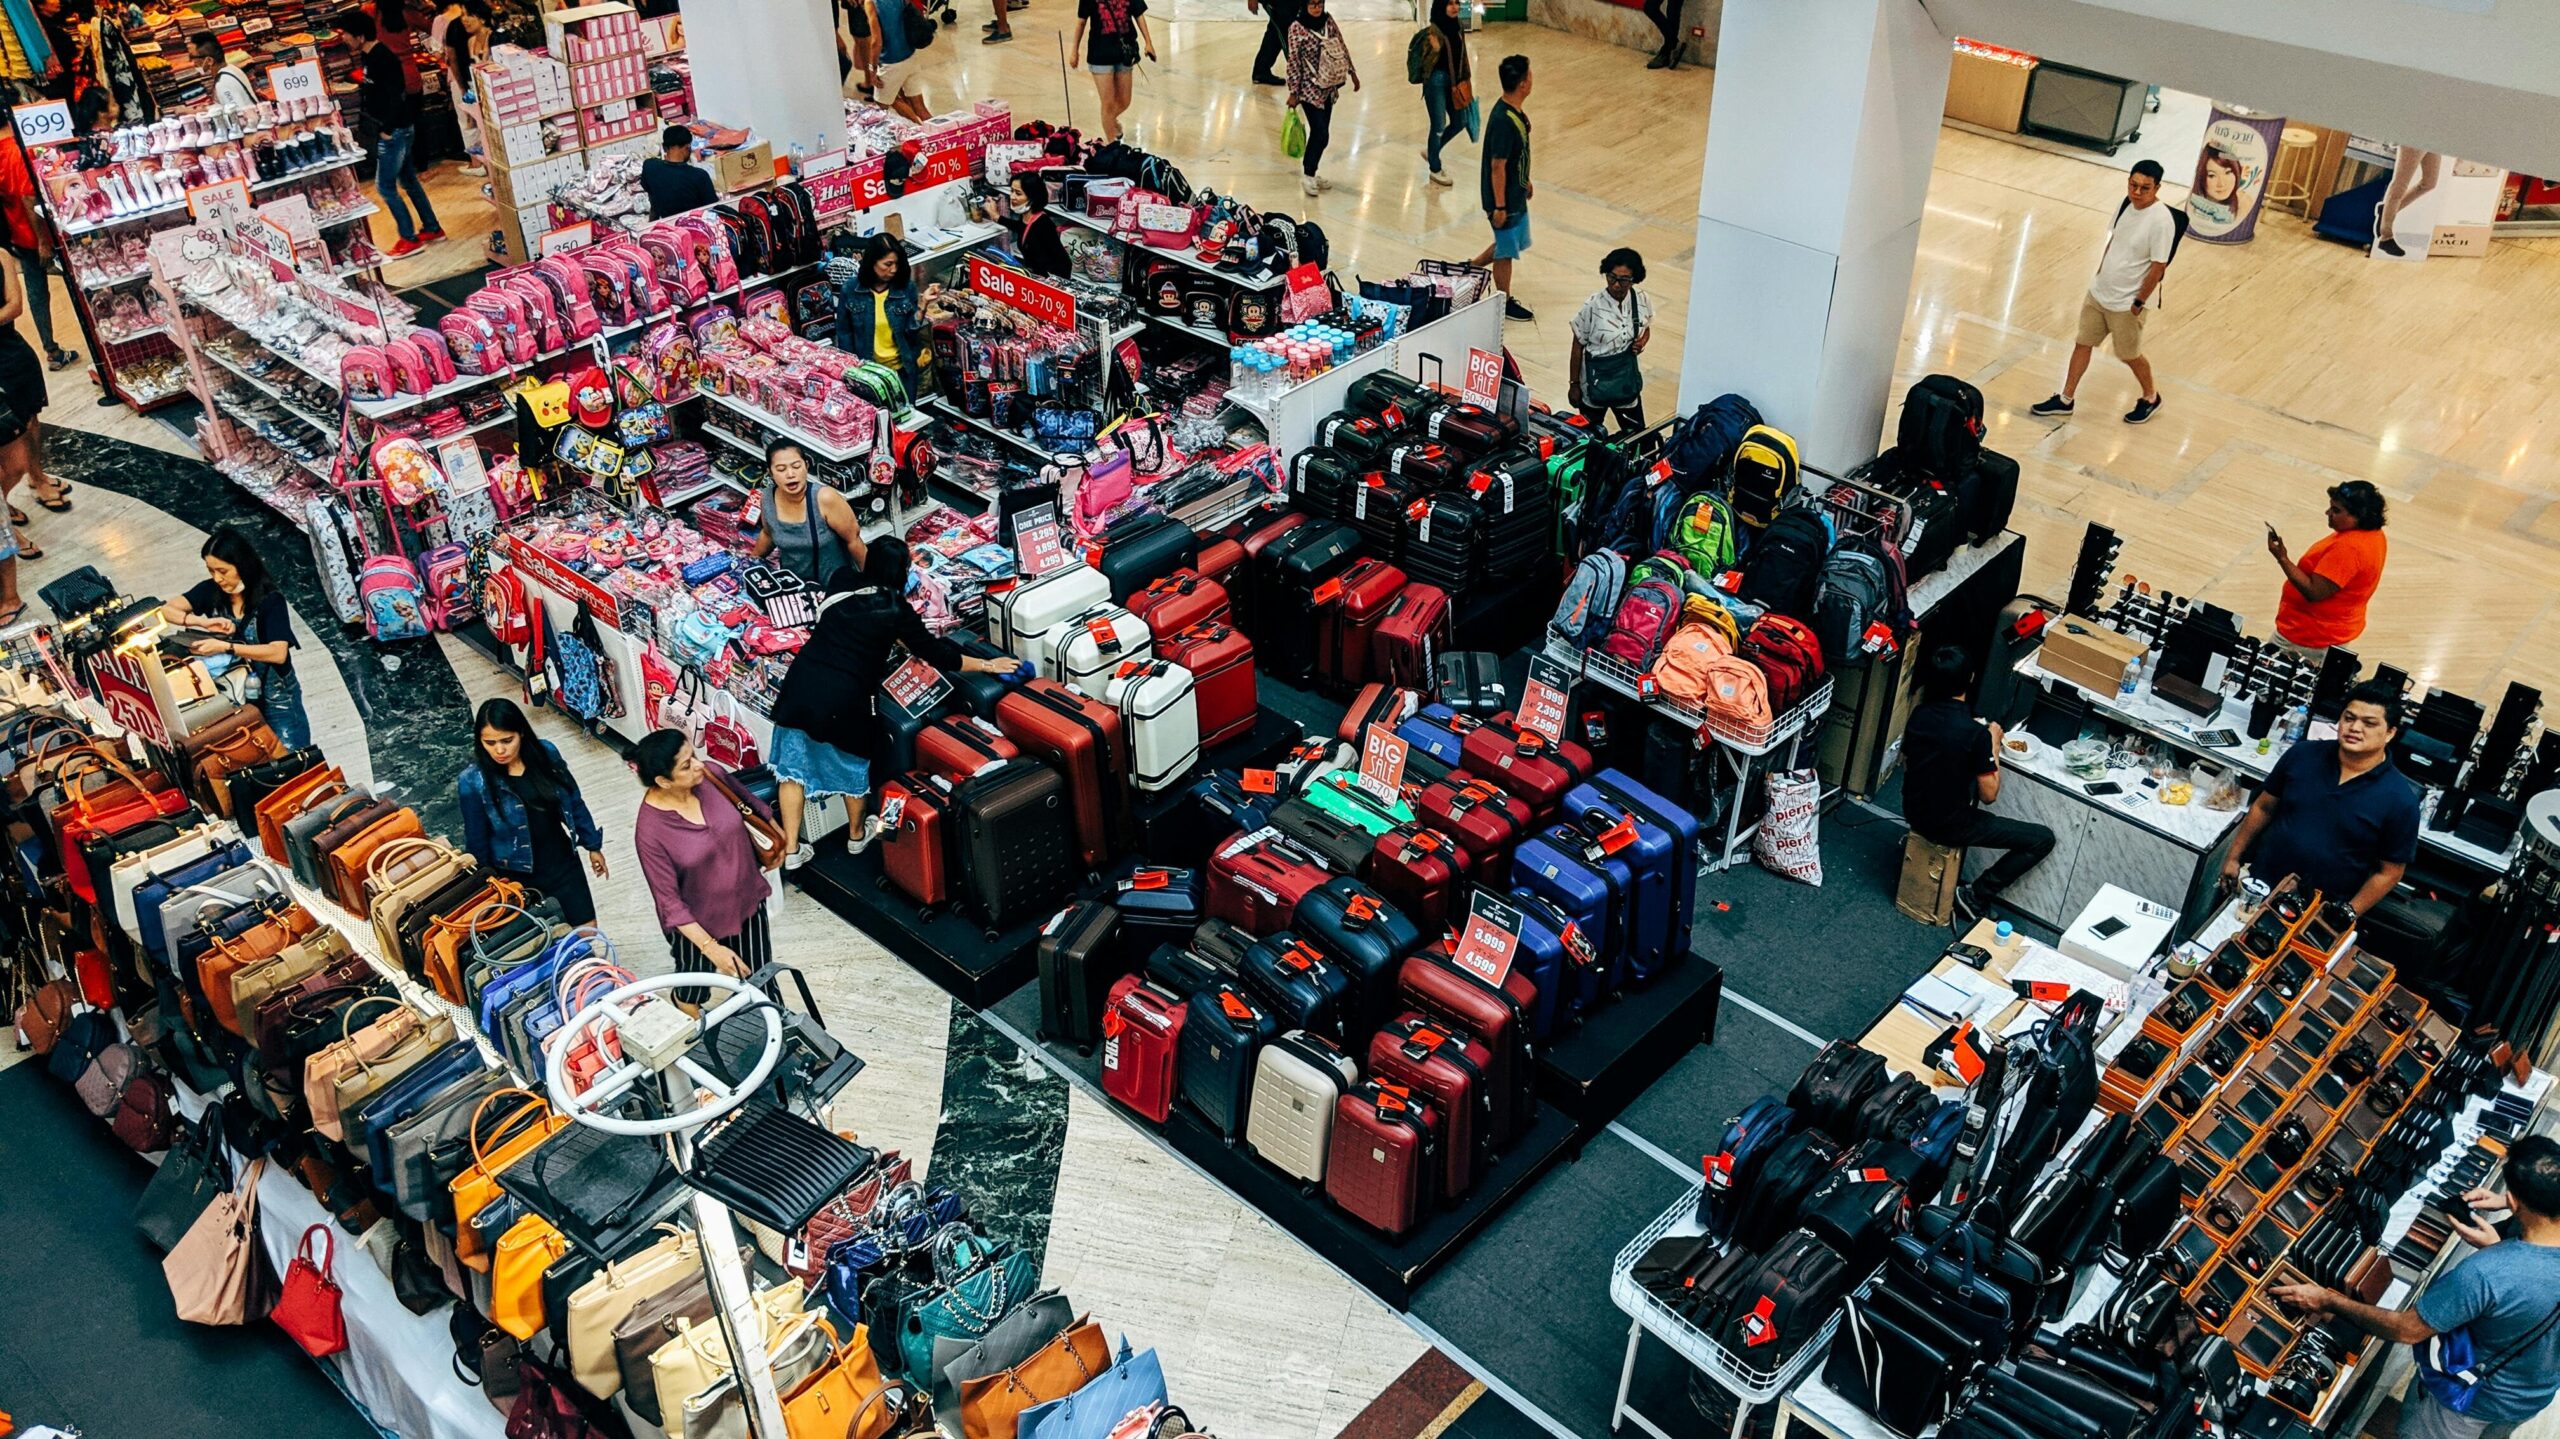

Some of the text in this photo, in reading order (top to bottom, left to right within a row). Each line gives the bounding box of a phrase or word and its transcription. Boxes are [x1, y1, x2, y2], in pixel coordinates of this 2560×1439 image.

[283, 74, 309, 90] 699
[21, 112, 65, 136] 699
[201, 188, 235, 205] SALE
[266, 230, 291, 259] 399
[979, 266, 1067, 319] Sale 50-70 %
[1471, 354, 1499, 378] BIG
[1471, 372, 1494, 397] SALE
[1018, 519, 1033, 531] ONE
[1034, 512, 1053, 525] PRICE
[520, 546, 559, 585] Sale
[104, 690, 156, 740] 250
[1368, 734, 1401, 765] BIG
[1368, 755, 1396, 785] SALE
[1775, 801, 1814, 823] pierre
[1776, 831, 1811, 851] pierre
[1481, 908, 1494, 919] ONE
[1495, 915, 1511, 929] PRICE
[1474, 927, 1506, 953] 3,999
[1465, 950, 1497, 976] 4,599
